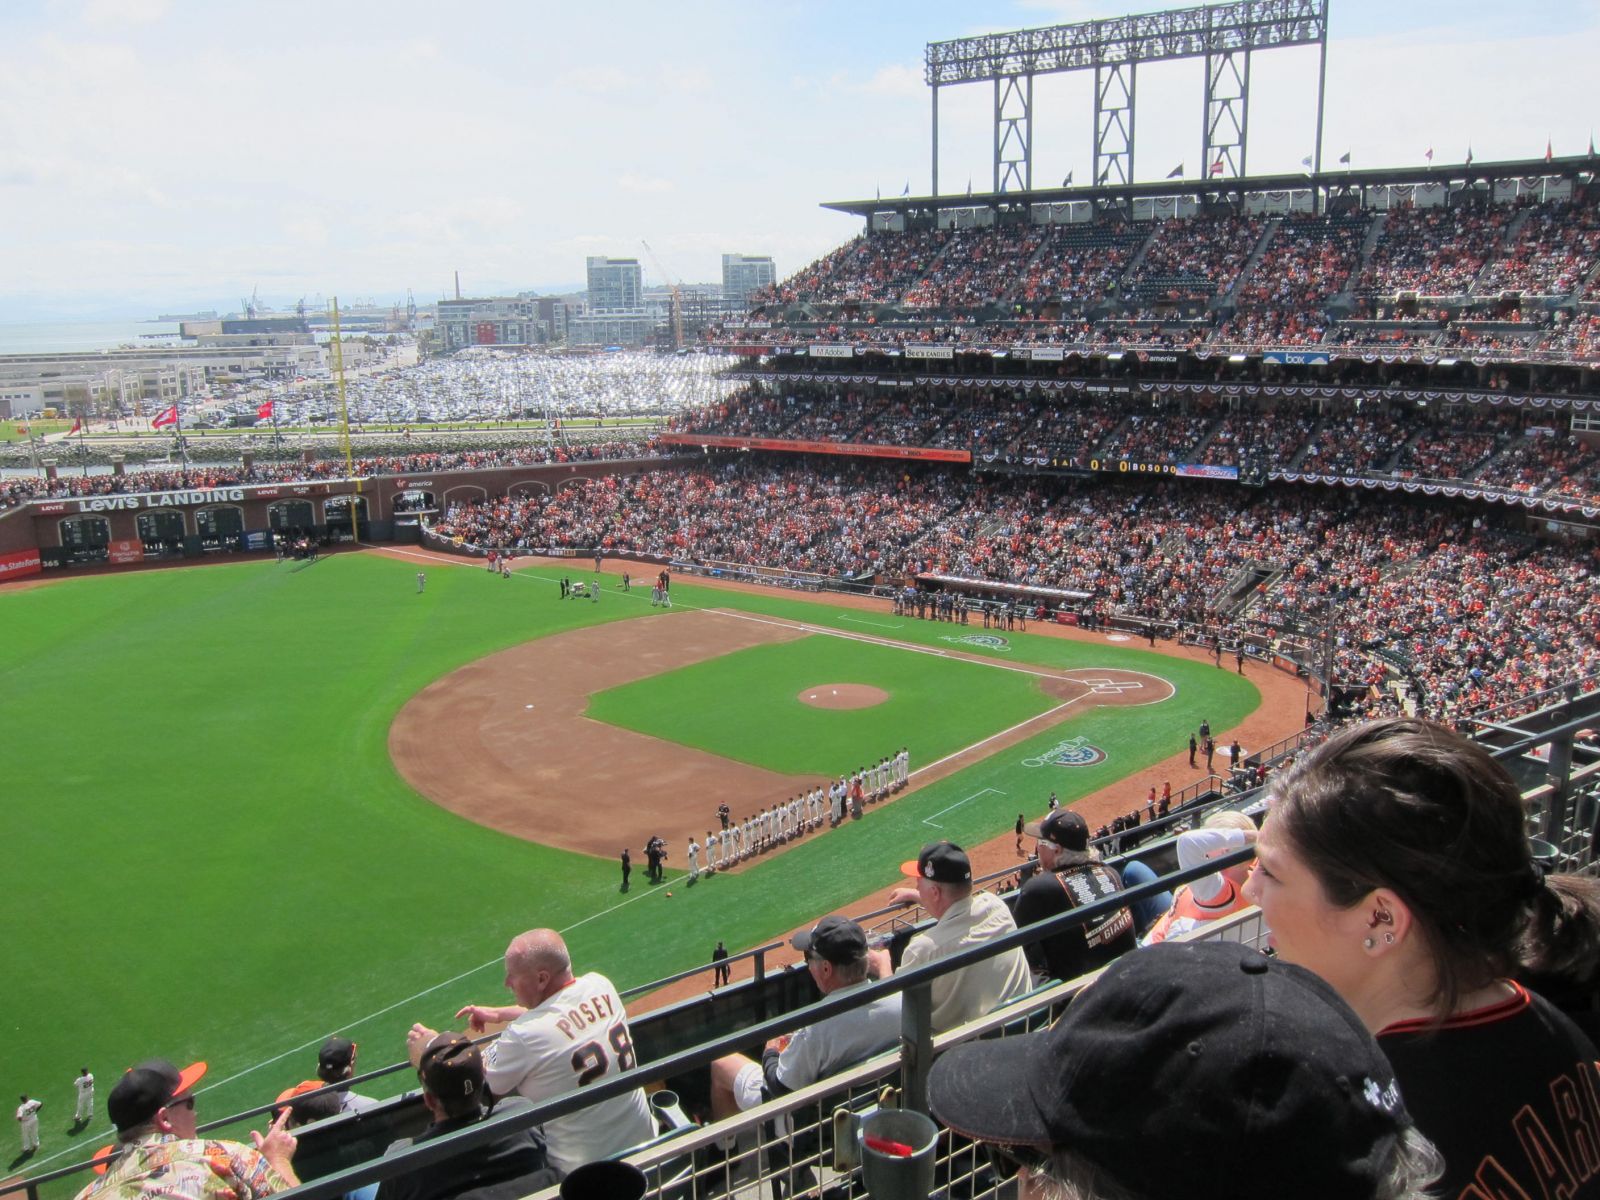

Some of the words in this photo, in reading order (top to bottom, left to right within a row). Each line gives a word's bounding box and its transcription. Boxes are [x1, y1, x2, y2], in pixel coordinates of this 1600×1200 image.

[1285, 353, 1305, 364] box
[408, 480, 433, 488] america
[146, 489, 244, 508] LANDING
[1104, 912, 1132, 940] GIANTS
[556, 994, 616, 1041] POSEY
[570, 1021, 636, 1088] 28
